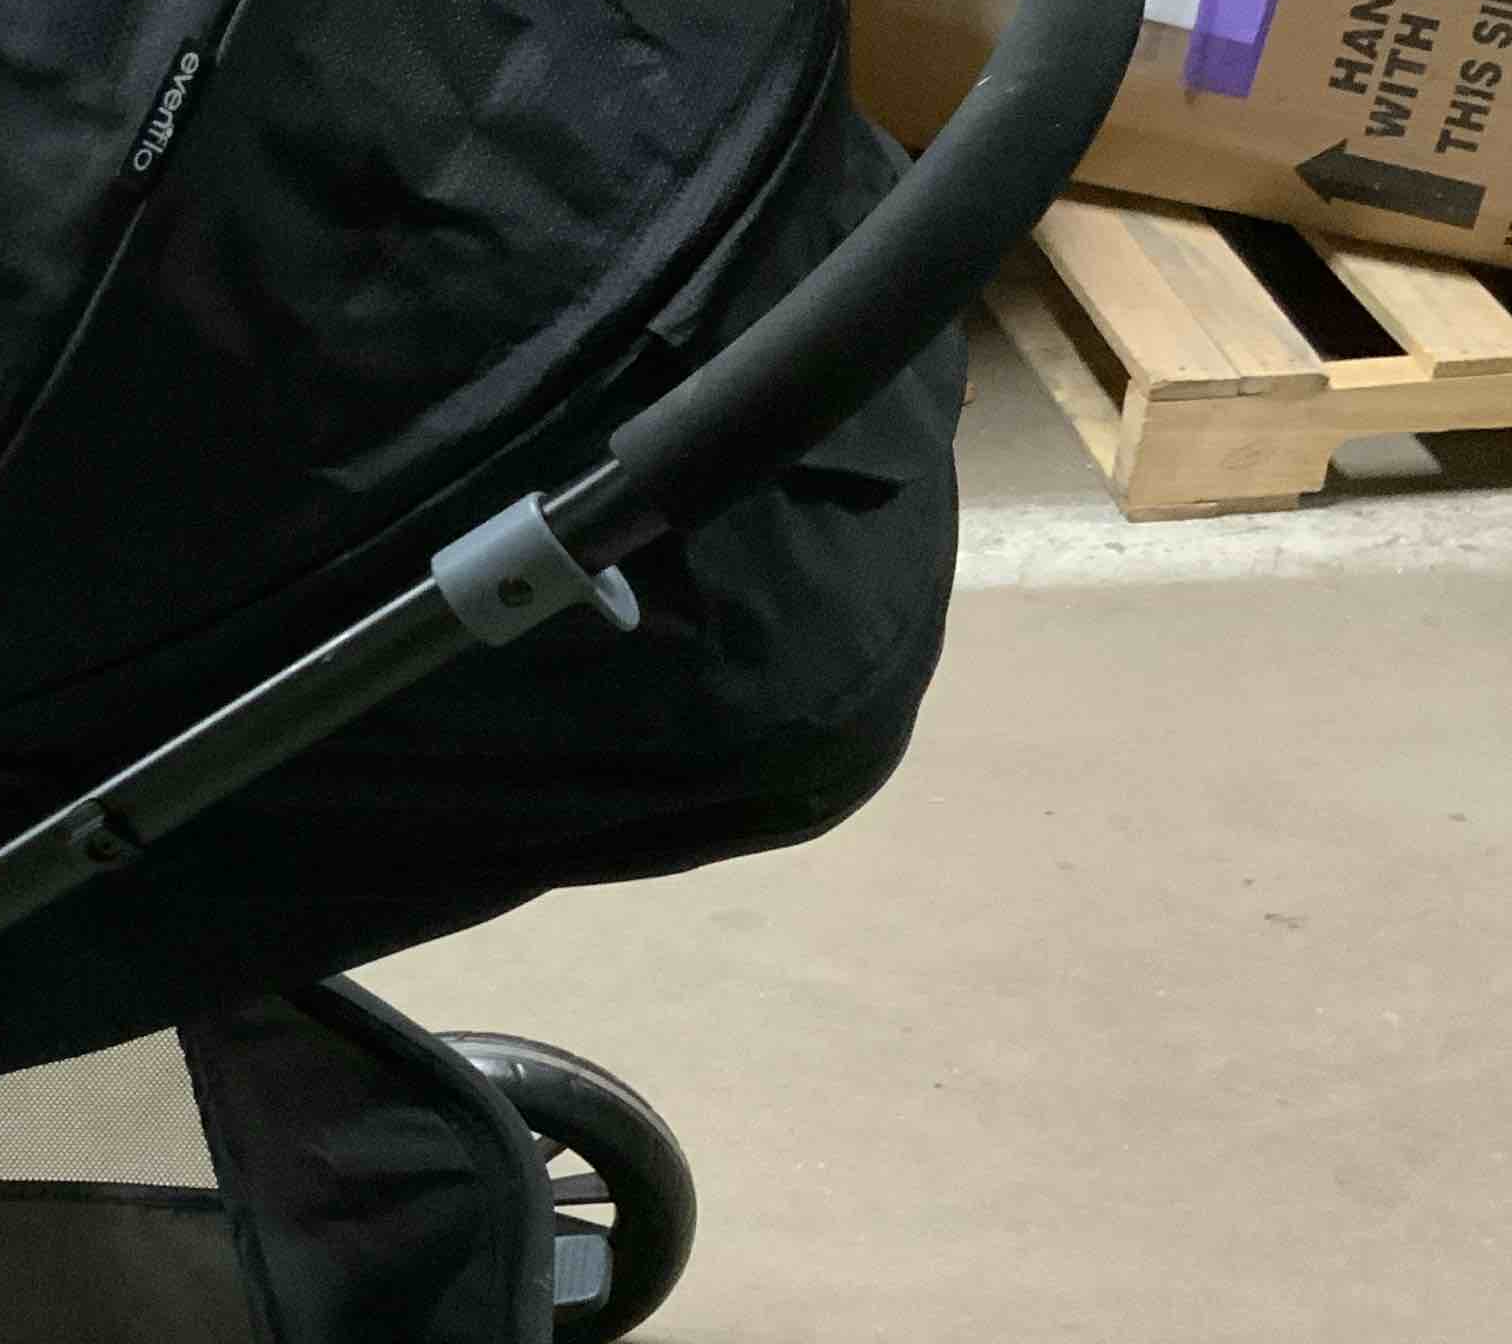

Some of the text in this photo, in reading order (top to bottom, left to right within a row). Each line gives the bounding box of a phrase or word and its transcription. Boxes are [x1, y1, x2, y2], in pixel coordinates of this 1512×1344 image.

[133, 52, 200, 171] evenflo
[1365, 13, 1440, 138] WITH
[1434, 58, 1503, 154] THIS
